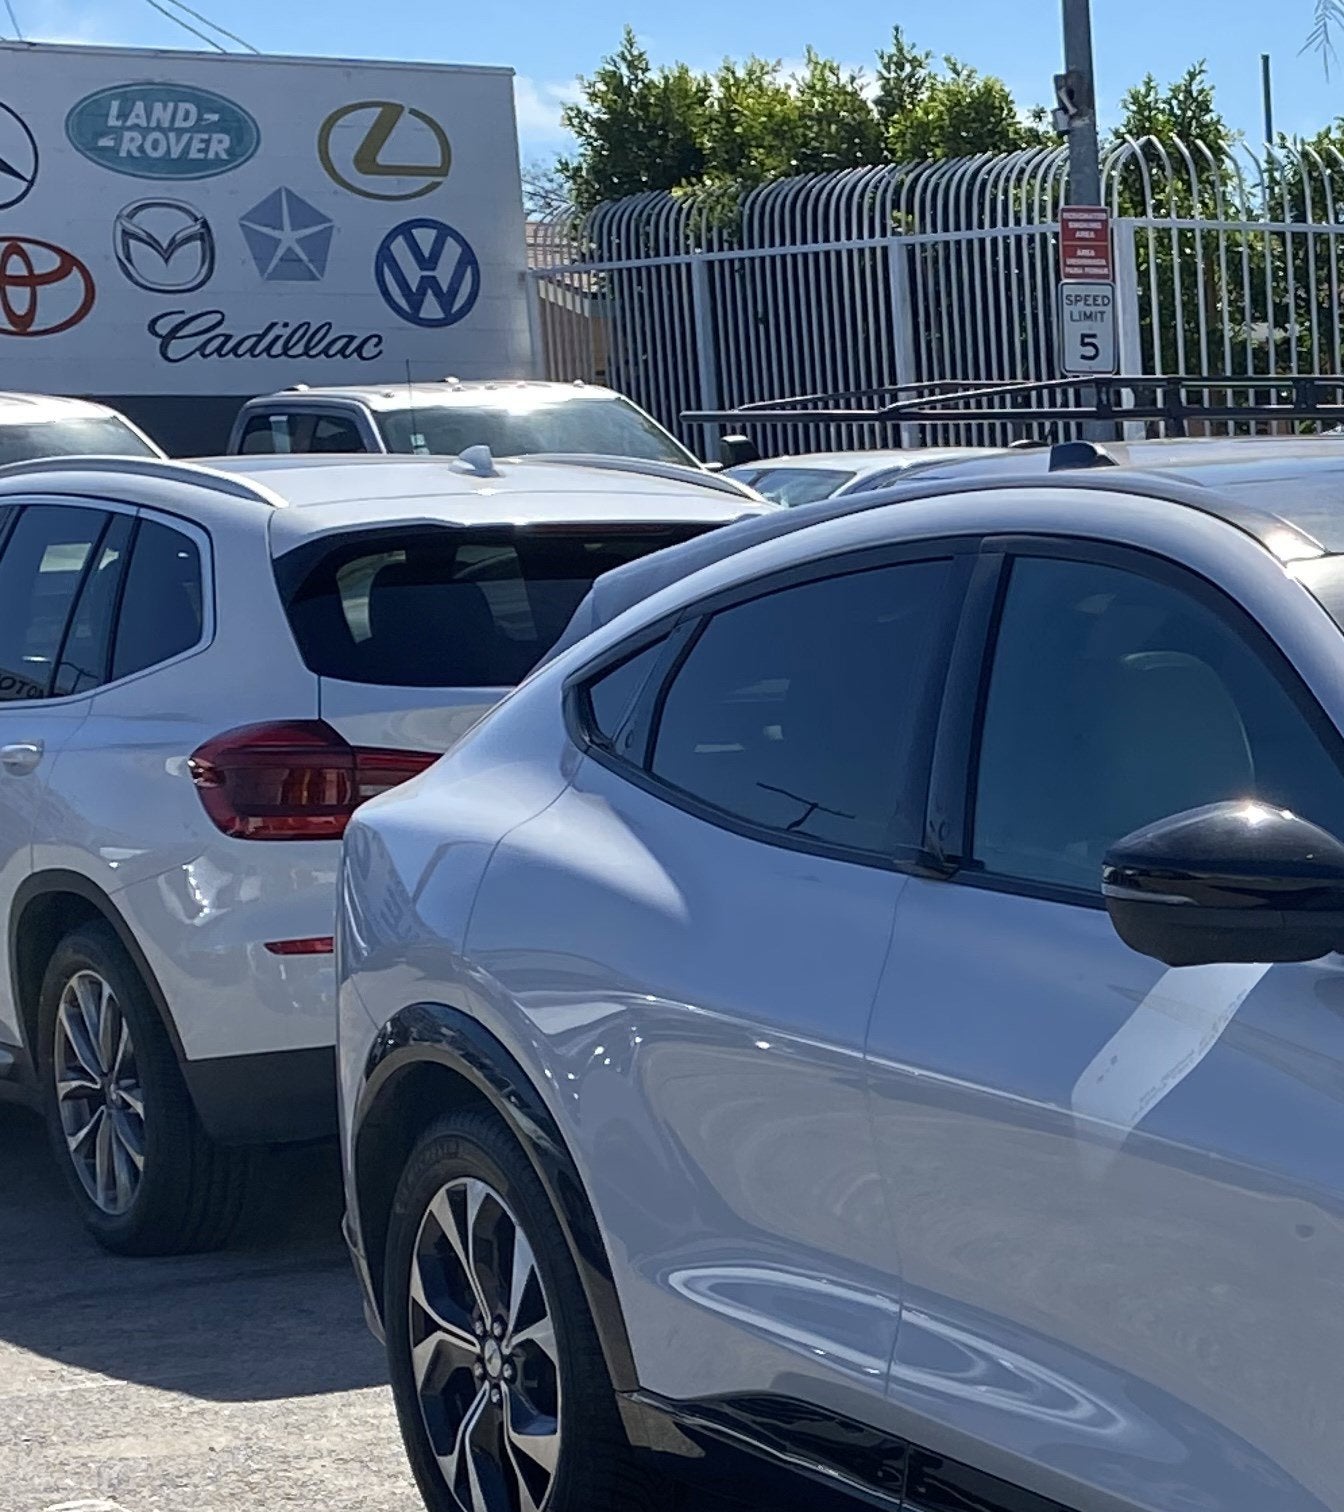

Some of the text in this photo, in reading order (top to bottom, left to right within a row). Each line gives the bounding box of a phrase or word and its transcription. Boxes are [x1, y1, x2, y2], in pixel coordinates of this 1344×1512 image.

[1065, 294, 1110, 307] SPEED
[1069, 310, 1106, 323] LIMIT
[147, 309, 383, 362] Cadillac
[1080, 333, 1099, 361] 5
